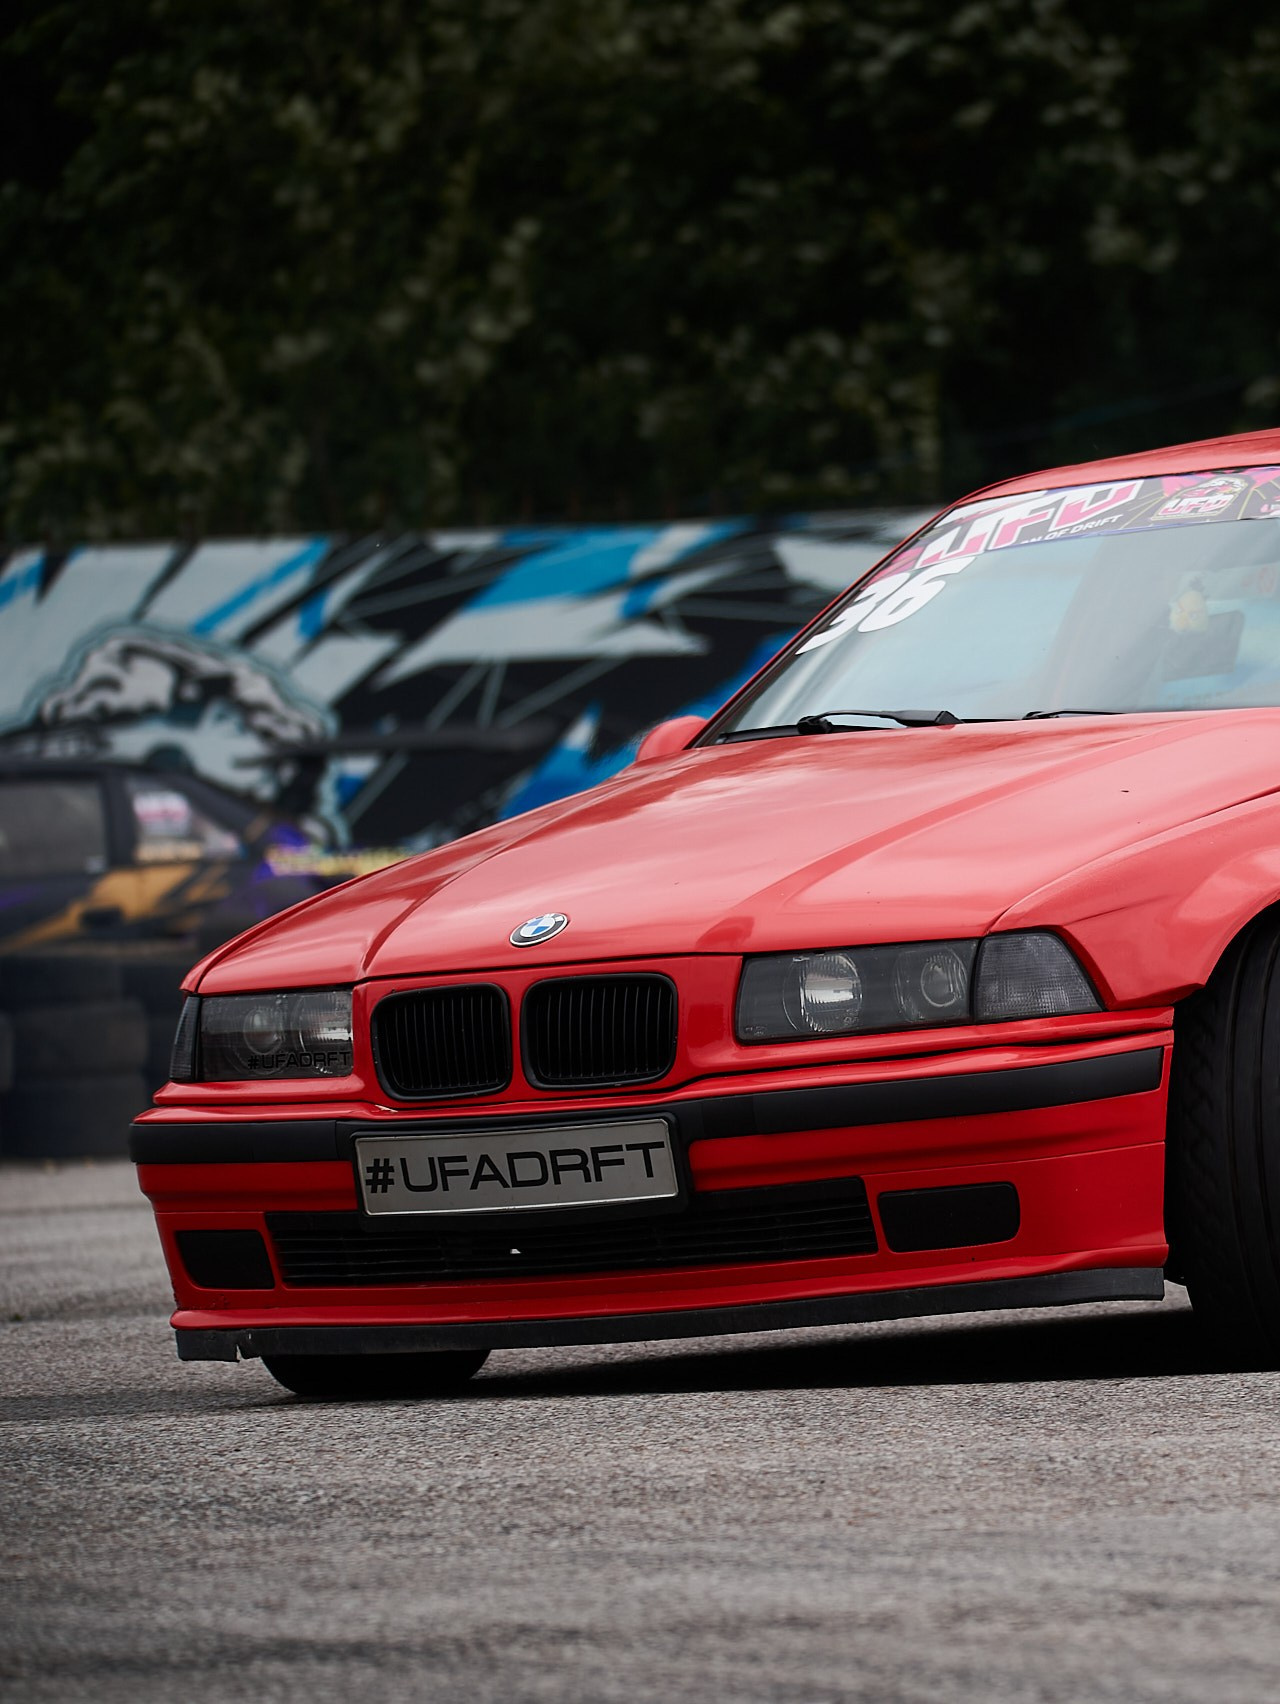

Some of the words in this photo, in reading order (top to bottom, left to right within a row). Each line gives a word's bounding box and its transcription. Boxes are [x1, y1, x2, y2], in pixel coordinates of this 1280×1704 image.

[1043, 528, 1070, 541] OF
[1069, 514, 1124, 534] DRIFT
[795, 556, 977, 656] 36
[247, 1051, 351, 1070] #UFADRFT
[365, 1141, 665, 1194] #UFADRFT
